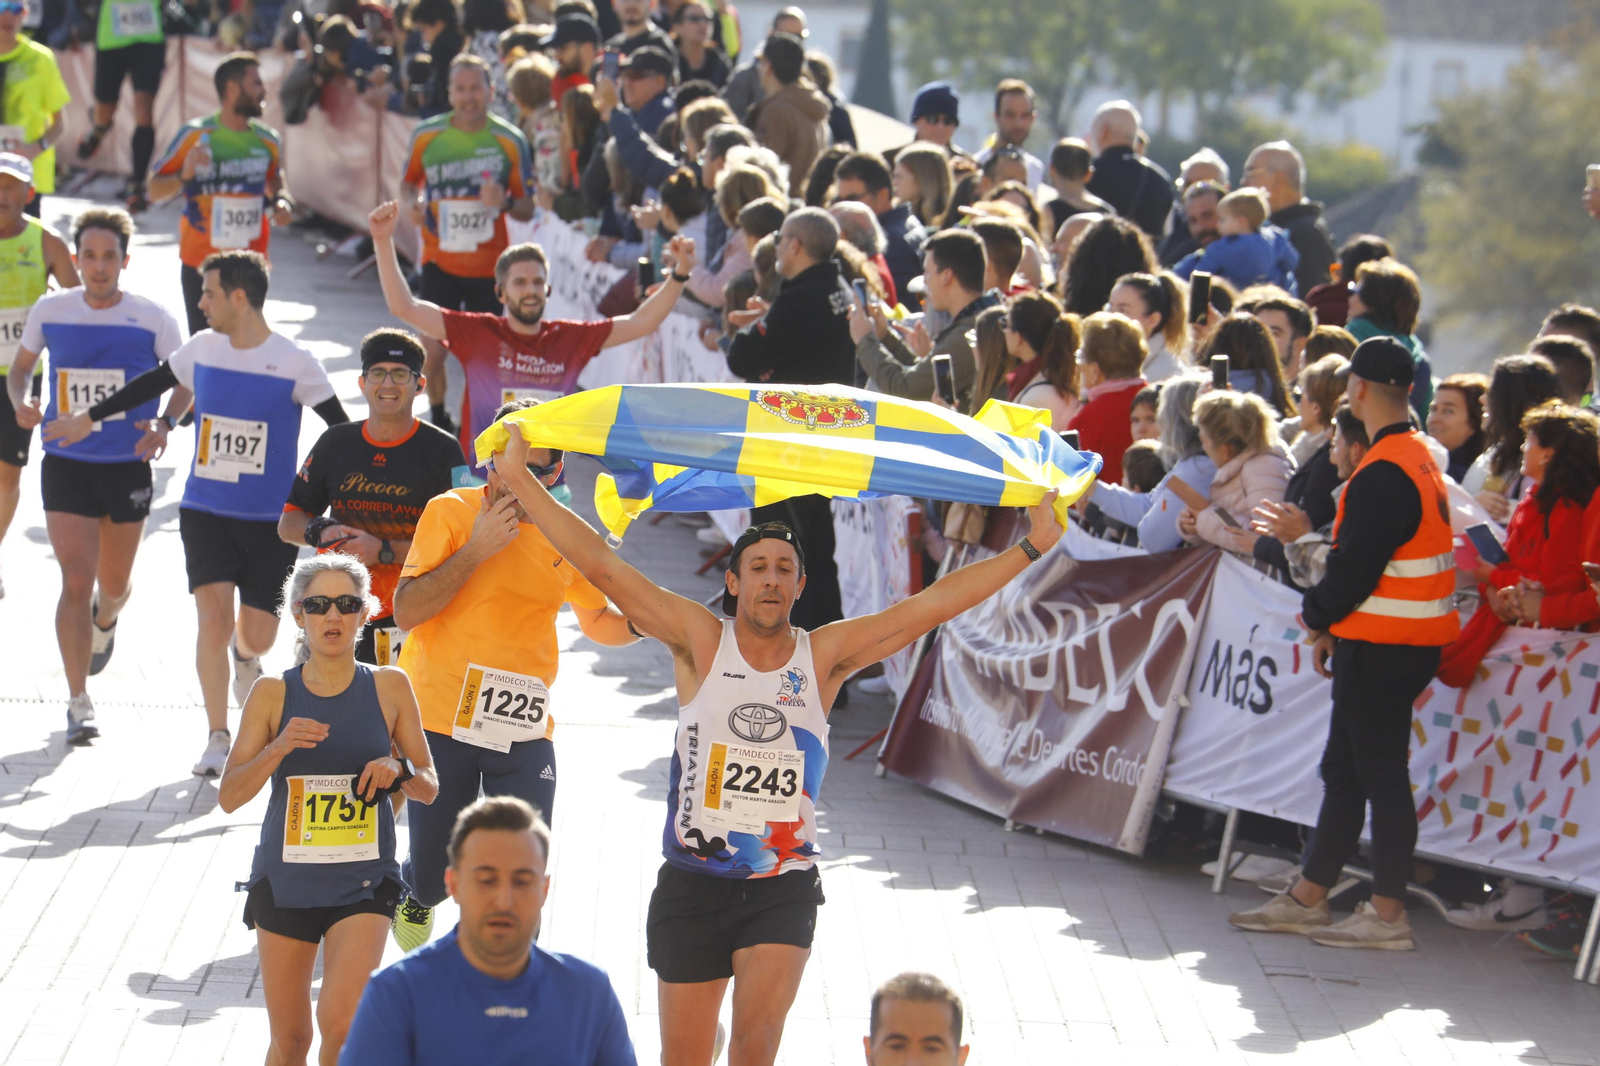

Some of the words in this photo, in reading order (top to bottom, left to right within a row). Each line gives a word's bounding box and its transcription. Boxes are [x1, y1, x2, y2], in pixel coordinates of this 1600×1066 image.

[451, 211, 487, 229] 3027
[2, 322, 24, 341] 16
[498, 357, 513, 370] 36
[213, 432, 261, 456] 1197
[340, 471, 412, 496] Picoco
[392, 642, 402, 660] 1
[1199, 624, 1278, 715] Más
[494, 674, 526, 687] IMDECO
[463, 689, 475, 715] CAJÓN
[481, 686, 545, 723] 1225
[776, 700, 807, 708] HUELVA
[482, 715, 500, 723] IGNACIO
[500, 719, 517, 727] LUCENA
[517, 722, 534, 730] CEREZO
[738, 748, 776, 761] IMDECO
[314, 778, 348, 787] IMDECO
[540, 773, 555, 781] adidas
[680, 722, 699, 829] TRIATLON
[709, 767, 719, 795] CAJÓN
[723, 762, 797, 797] 2243
[290, 802, 300, 830] CAJÓN
